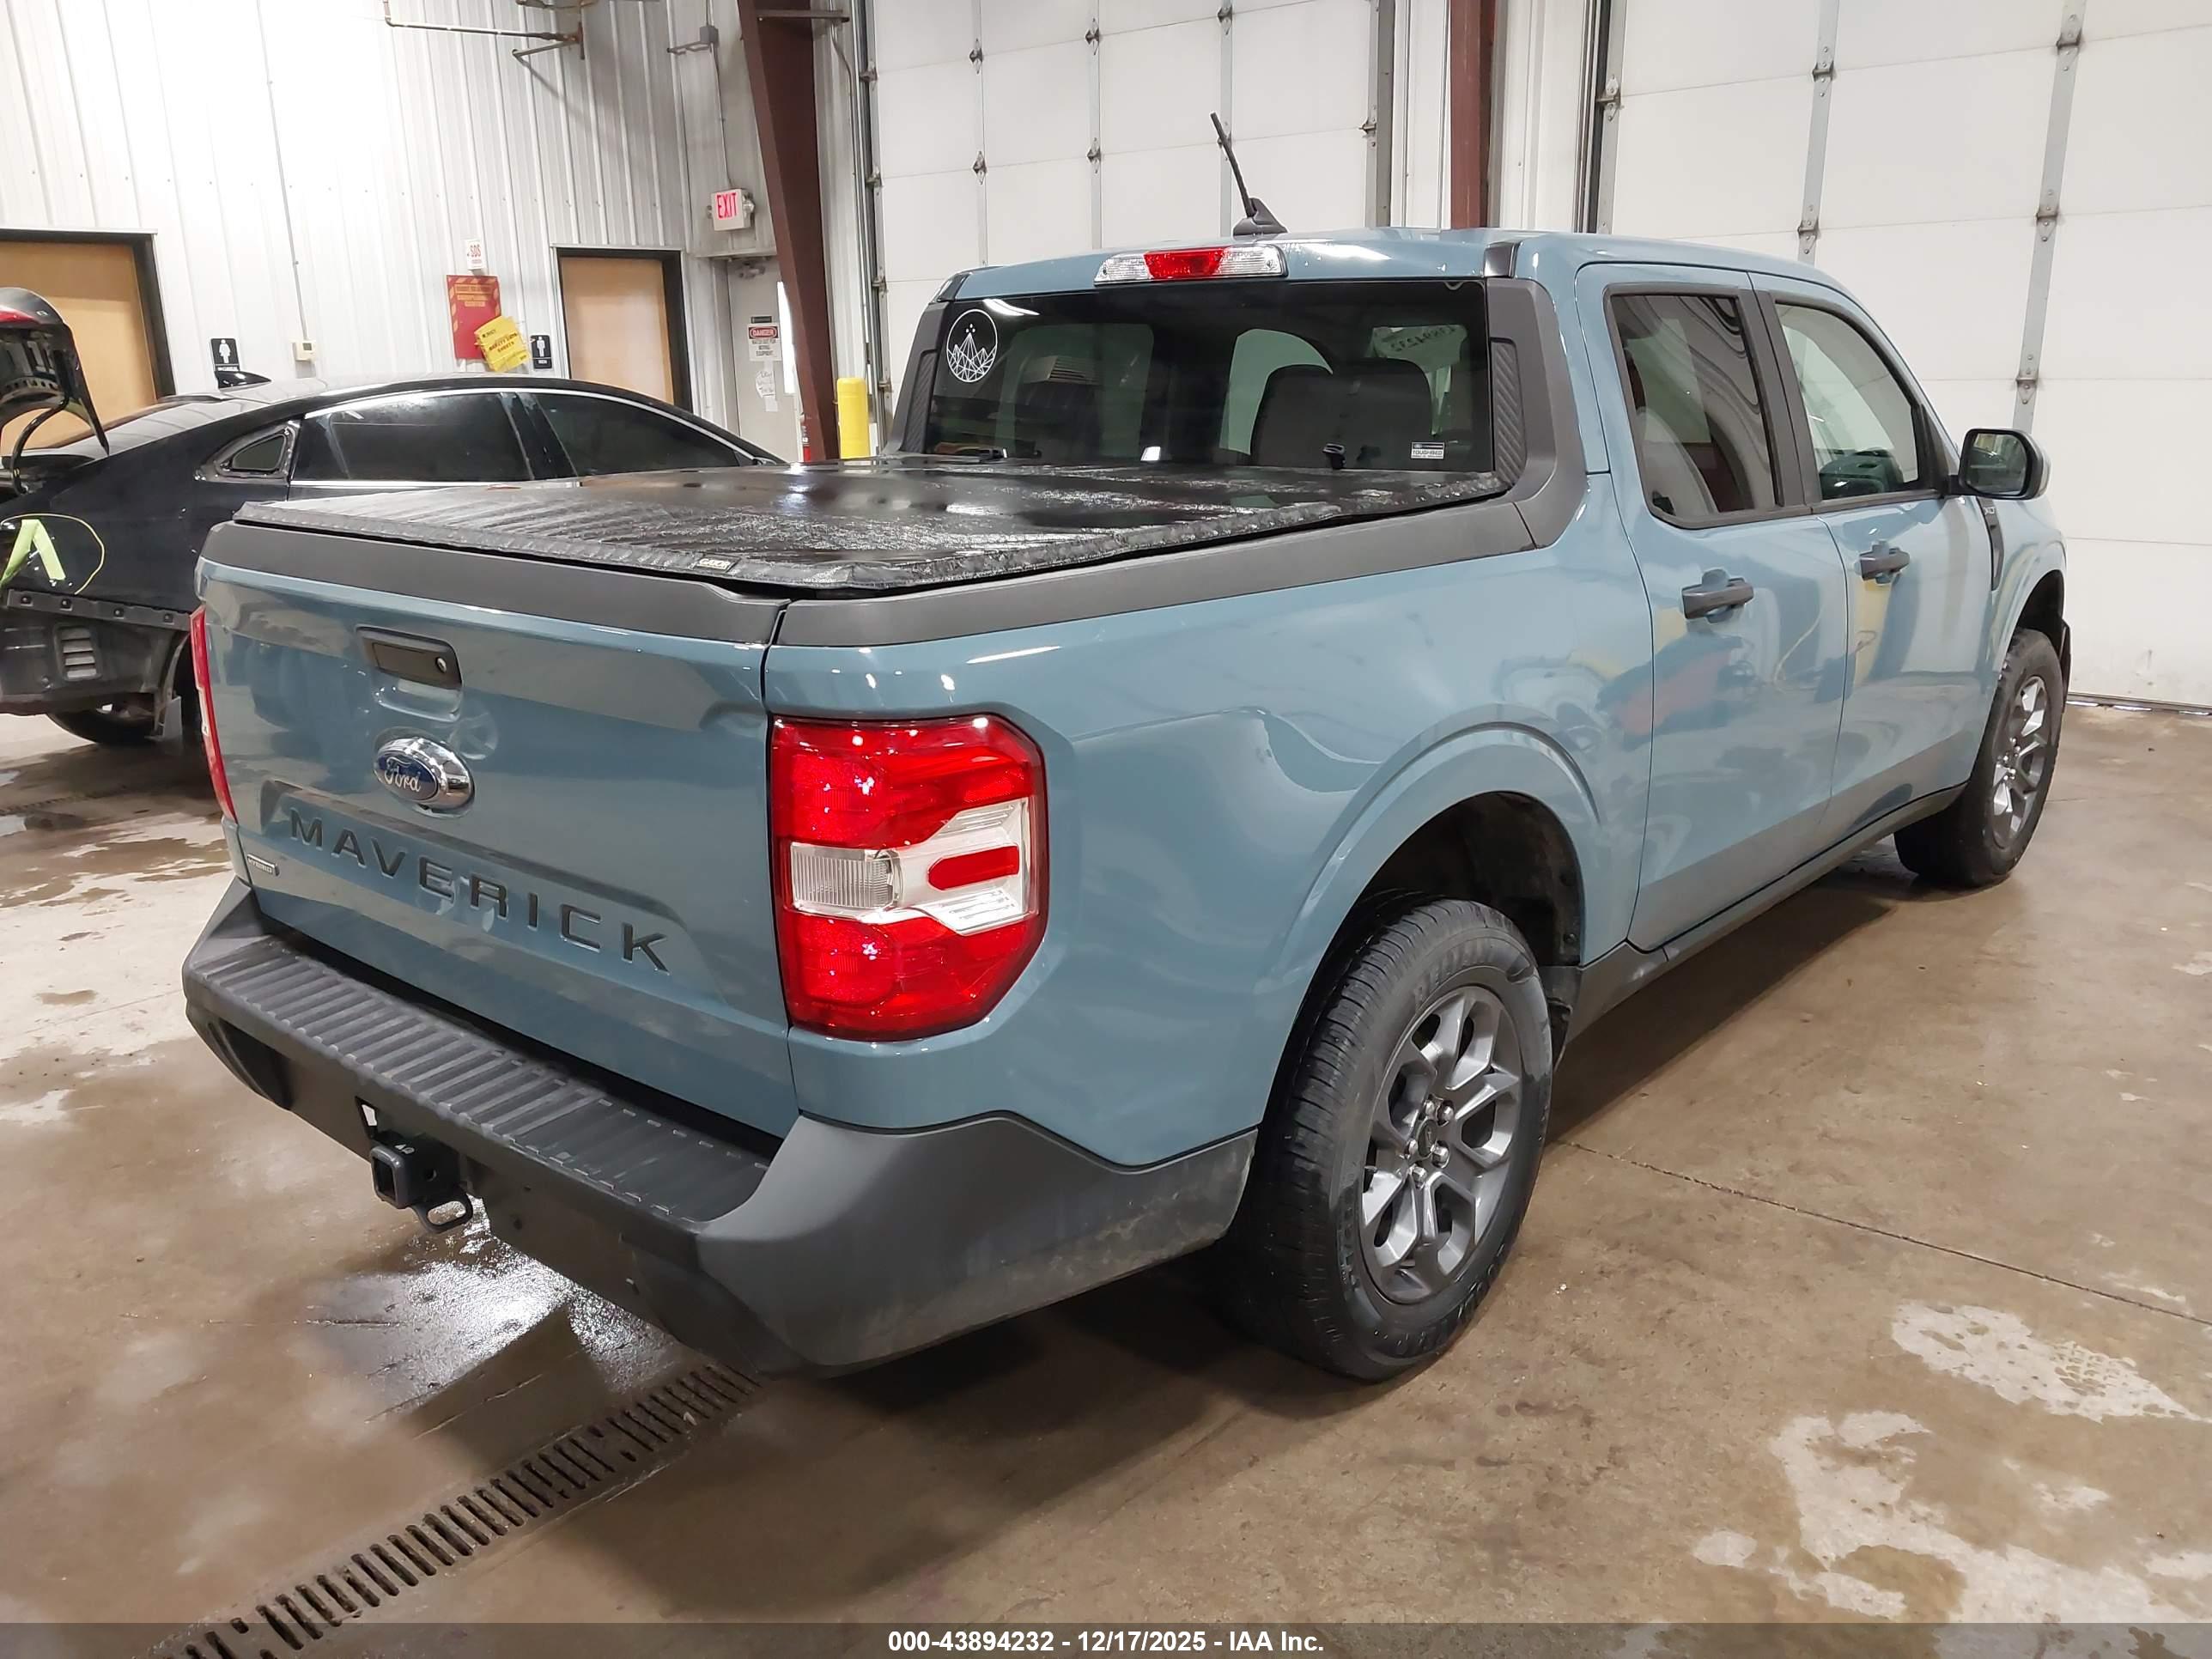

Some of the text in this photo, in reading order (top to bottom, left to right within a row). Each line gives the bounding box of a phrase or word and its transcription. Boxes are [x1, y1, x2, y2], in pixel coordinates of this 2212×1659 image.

[716, 191, 737, 218] EXIT
[384, 756, 422, 793] Ford
[289, 807, 671, 975] MAVERICK
